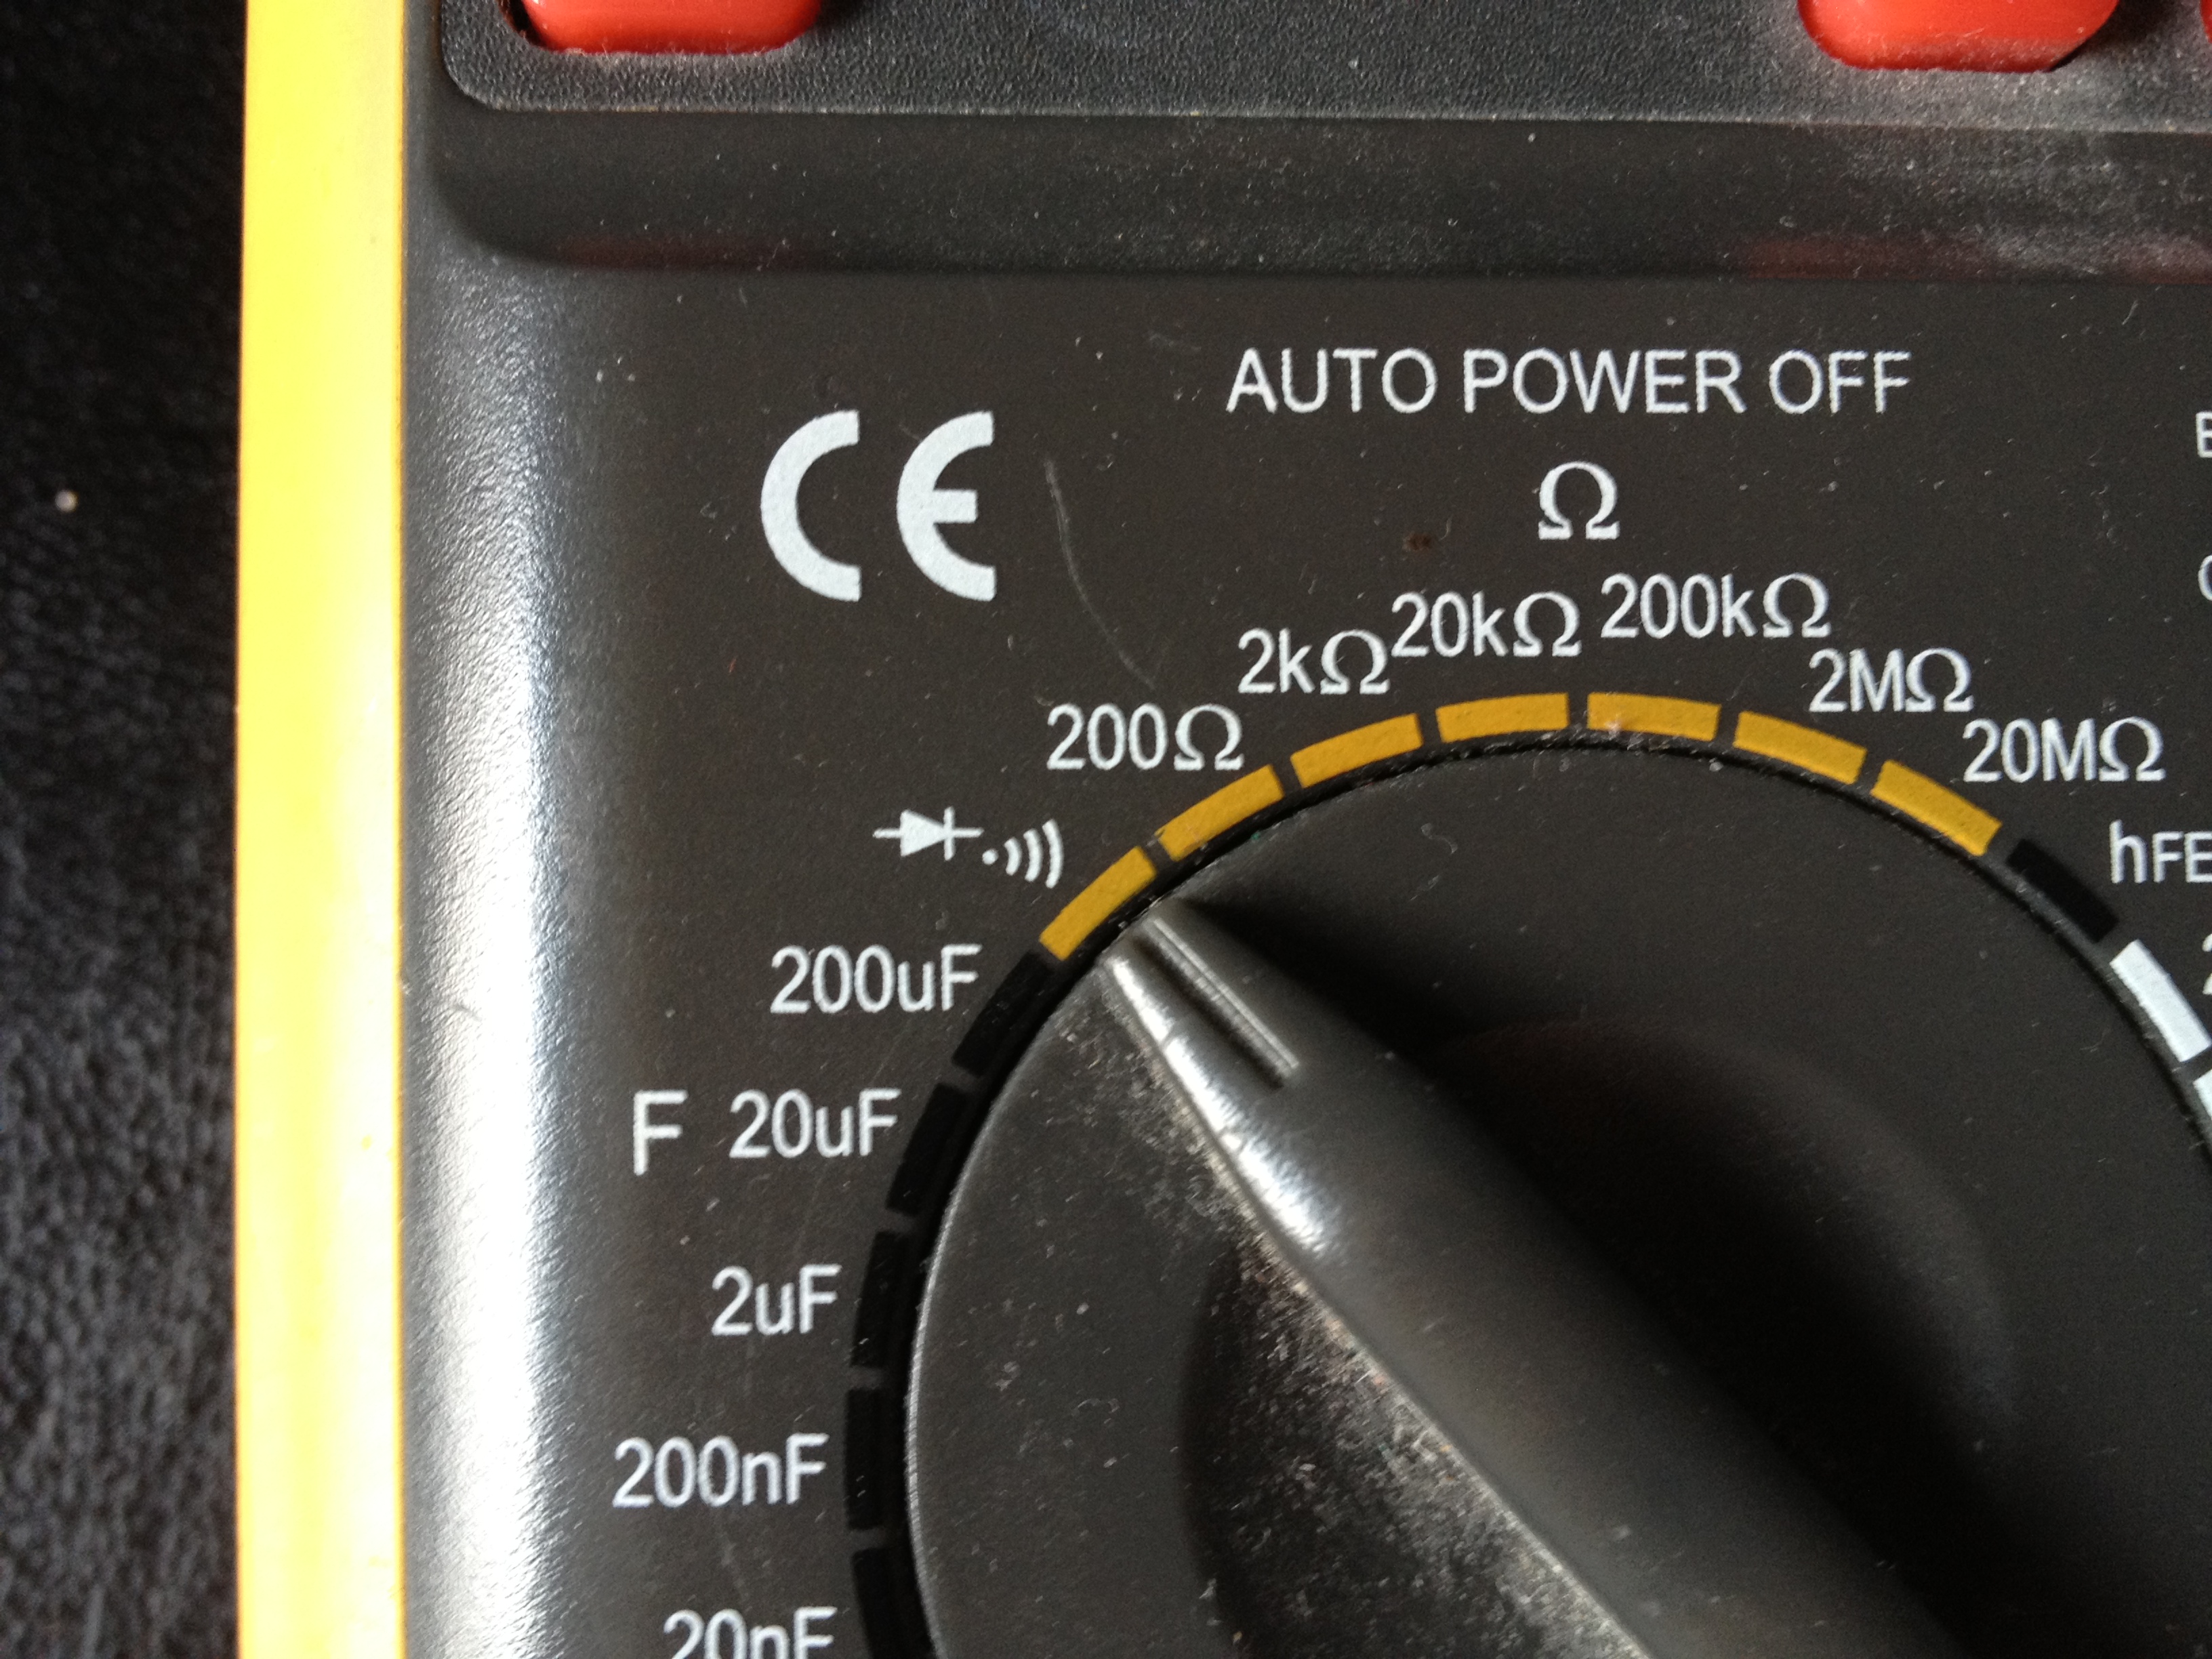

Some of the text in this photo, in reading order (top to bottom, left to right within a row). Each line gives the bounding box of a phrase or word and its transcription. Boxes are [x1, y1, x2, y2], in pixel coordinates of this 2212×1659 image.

[1225, 347, 1910, 415] AUTO POWER OFF
[759, 409, 997, 602] CE
[1390, 591, 1582, 658] 20kΩ
[1600, 572, 1831, 639] 200kΩ
[1237, 627, 1390, 695] 2kΩ
[1808, 647, 1973, 713] 2MΩ
[1046, 702, 1244, 772] 200Ω
[1962, 716, 2166, 784] 20MΩ
[2108, 820, 2212, 884] hFE
[769, 943, 982, 1015] 200uF
[632, 1089, 689, 1176] F
[728, 1088, 901, 1160] 20uF
[710, 1263, 842, 1337] 2uF
[611, 1432, 830, 1509] 200nF
[663, 1605, 838, 1659] 20nF
